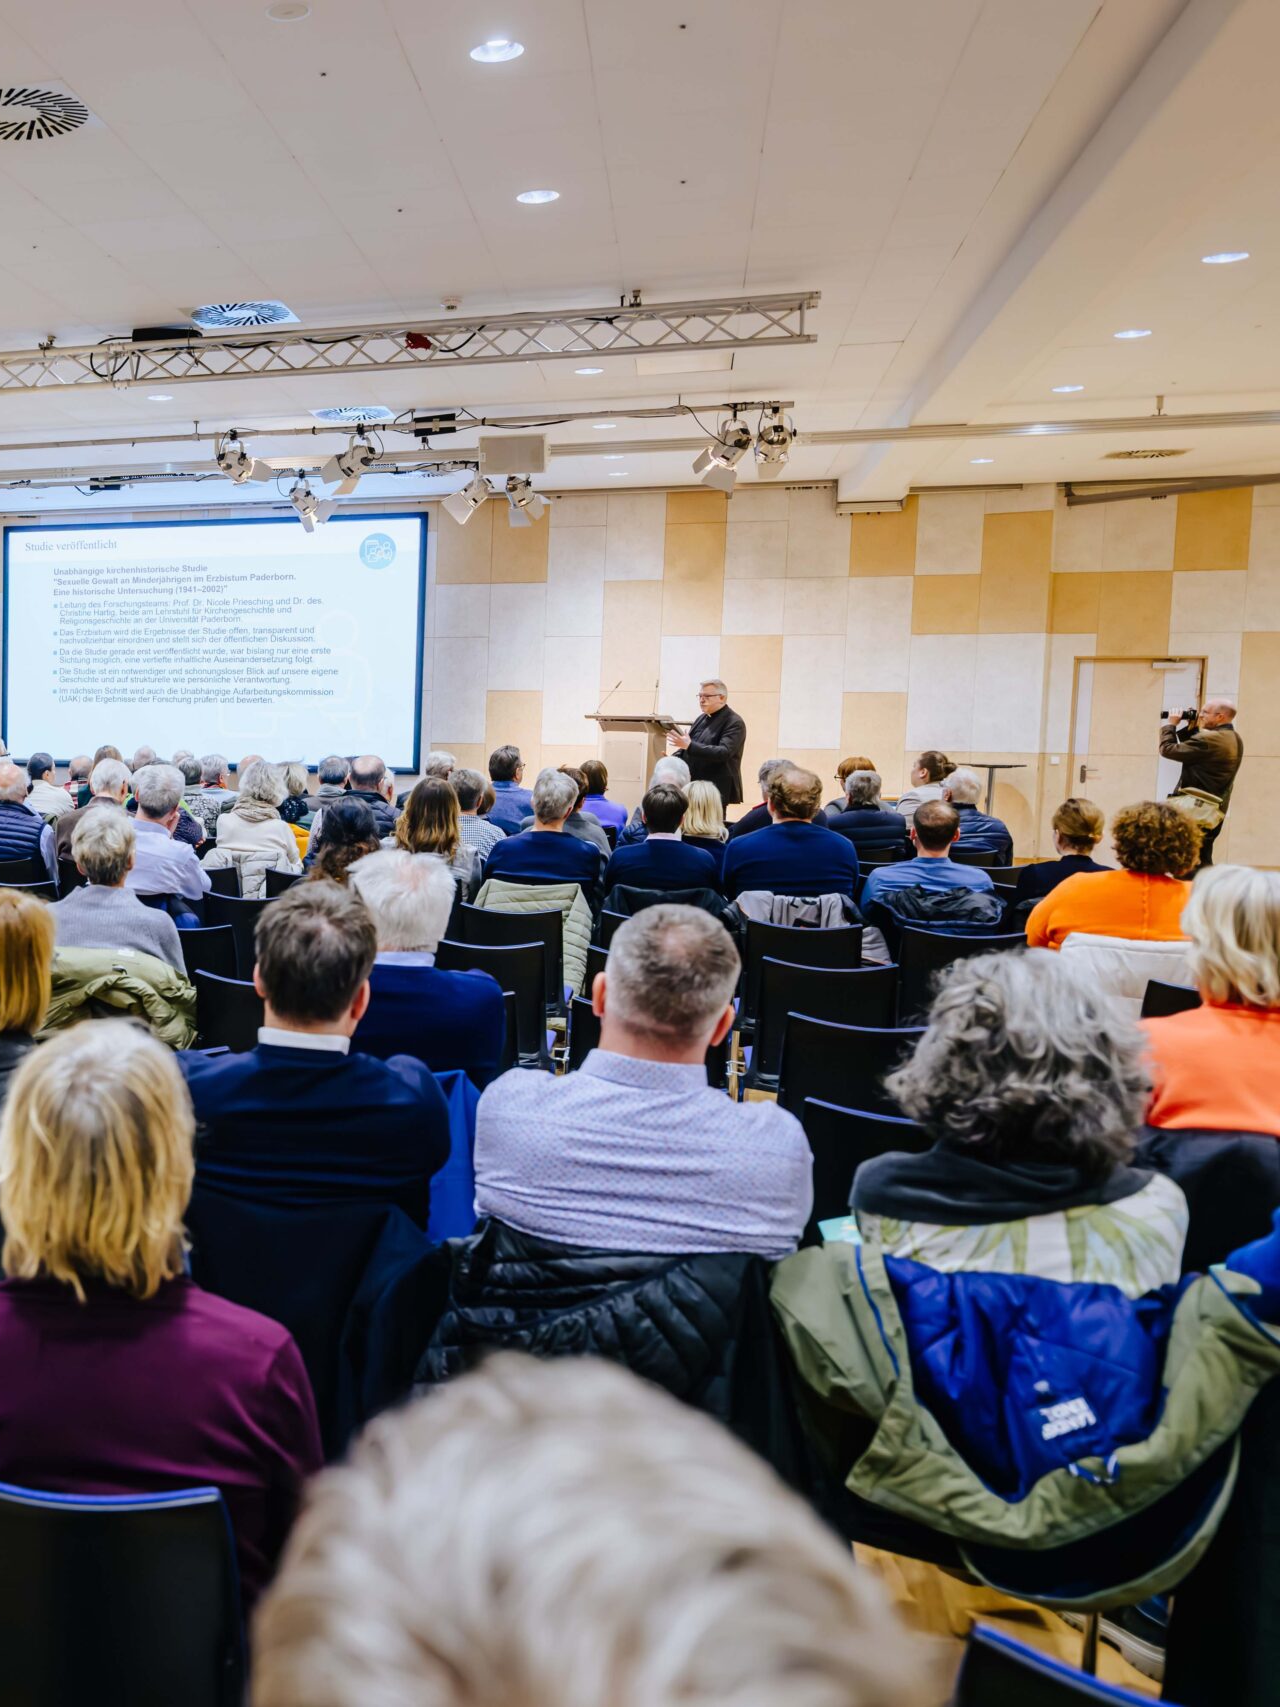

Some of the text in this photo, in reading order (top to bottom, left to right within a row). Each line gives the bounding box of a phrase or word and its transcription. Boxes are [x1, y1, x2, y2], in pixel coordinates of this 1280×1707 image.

[25, 539, 117, 552] Studie veröffentlicht
[53, 564, 208, 577] Unabhängige kirchenhistorische Studie
[92, 577, 118, 585] Gewalt
[132, 576, 192, 585] Minderjährigen
[206, 574, 247, 582] Erzbistum
[250, 573, 296, 581] Paderborn.
[117, 587, 173, 596] Untersuchung
